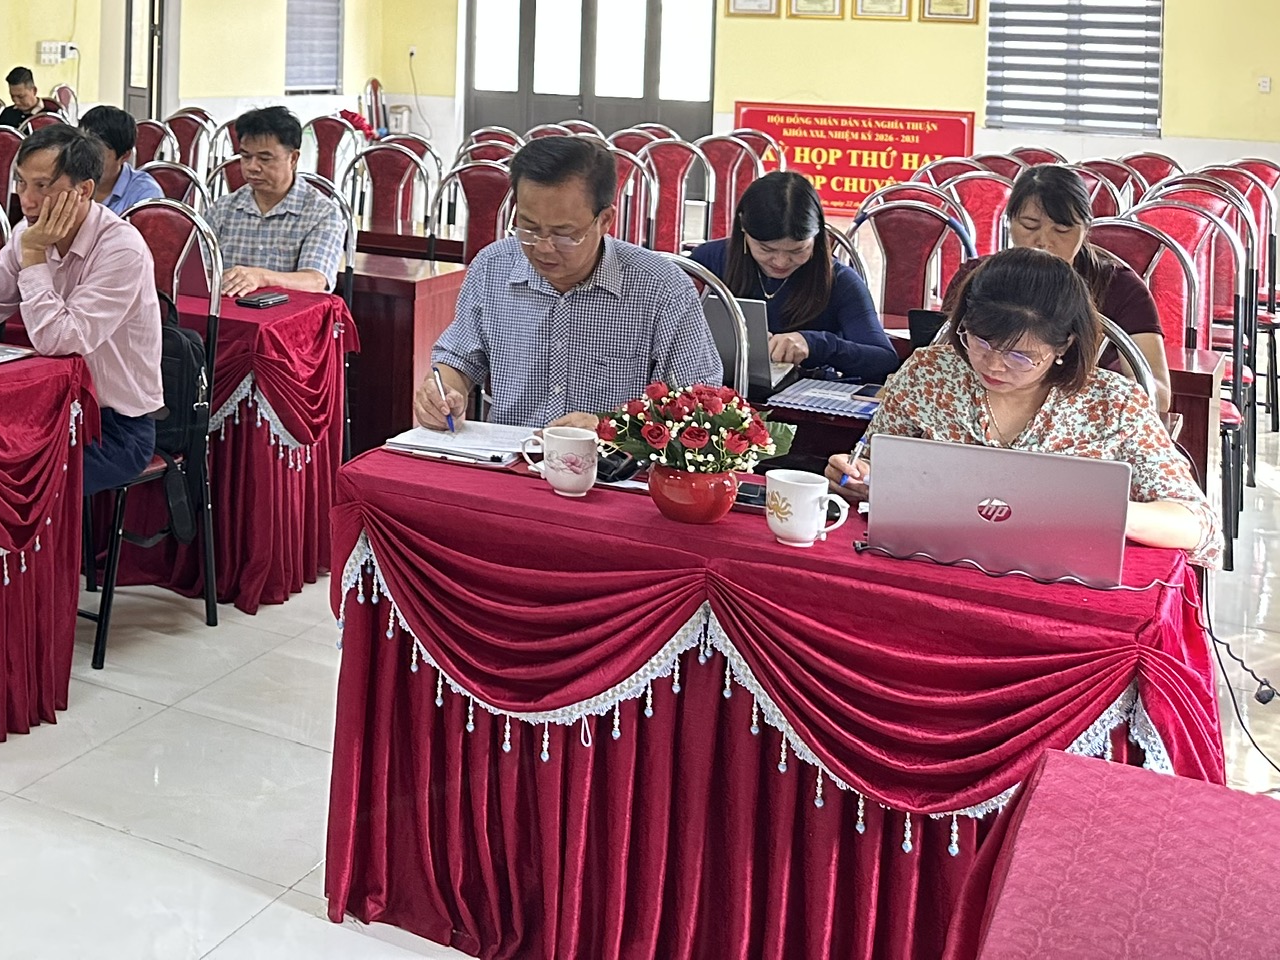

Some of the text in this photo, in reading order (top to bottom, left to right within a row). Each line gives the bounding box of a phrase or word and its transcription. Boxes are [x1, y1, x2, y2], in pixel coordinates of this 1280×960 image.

[767, 114, 784, 126] HỘI
[785, 113, 812, 124] ĐỒNG
[813, 116, 839, 126] NHÂN
[840, 117, 860, 127] DÂN
[874, 119, 904, 130] NGHĨA
[905, 121, 938, 134] THUẬN
[827, 130, 859, 141] NHIỆM
[874, 133, 894, 142] 2026
[900, 134, 920, 144] 2031
[793, 146, 843, 170] HỌP
[846, 146, 898, 170] THỨ
[979, 497, 1011, 523] hp
